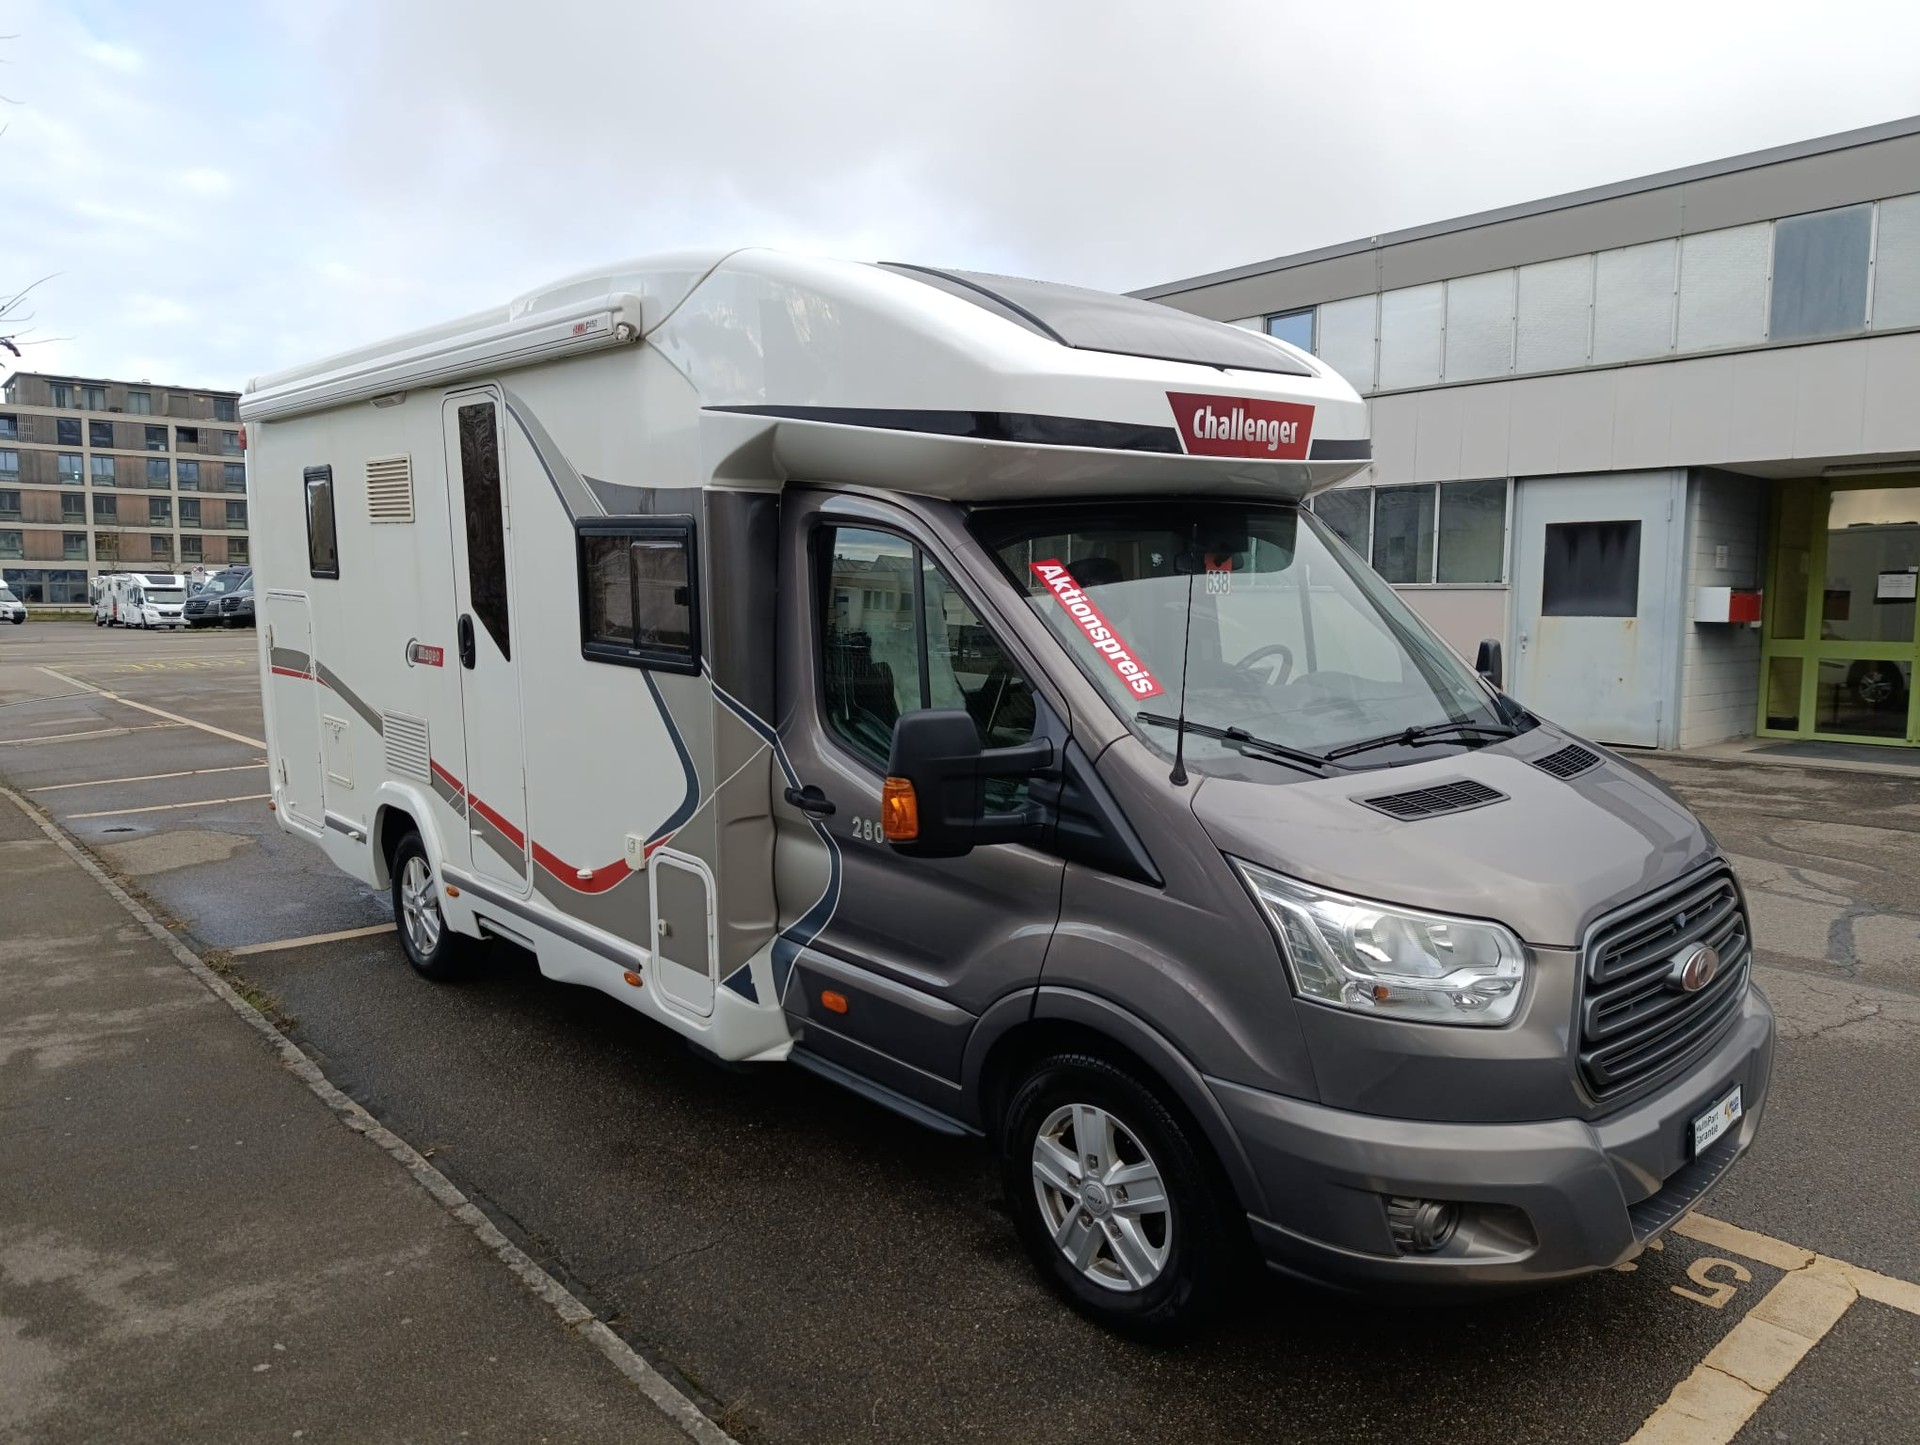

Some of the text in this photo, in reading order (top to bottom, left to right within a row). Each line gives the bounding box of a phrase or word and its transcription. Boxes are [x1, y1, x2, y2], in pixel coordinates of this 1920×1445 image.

[1193, 405, 1298, 452] Challenger
[1207, 570, 1229, 593] 638
[1036, 565, 1153, 694] Aktionspreis
[852, 816, 884, 844] 280
